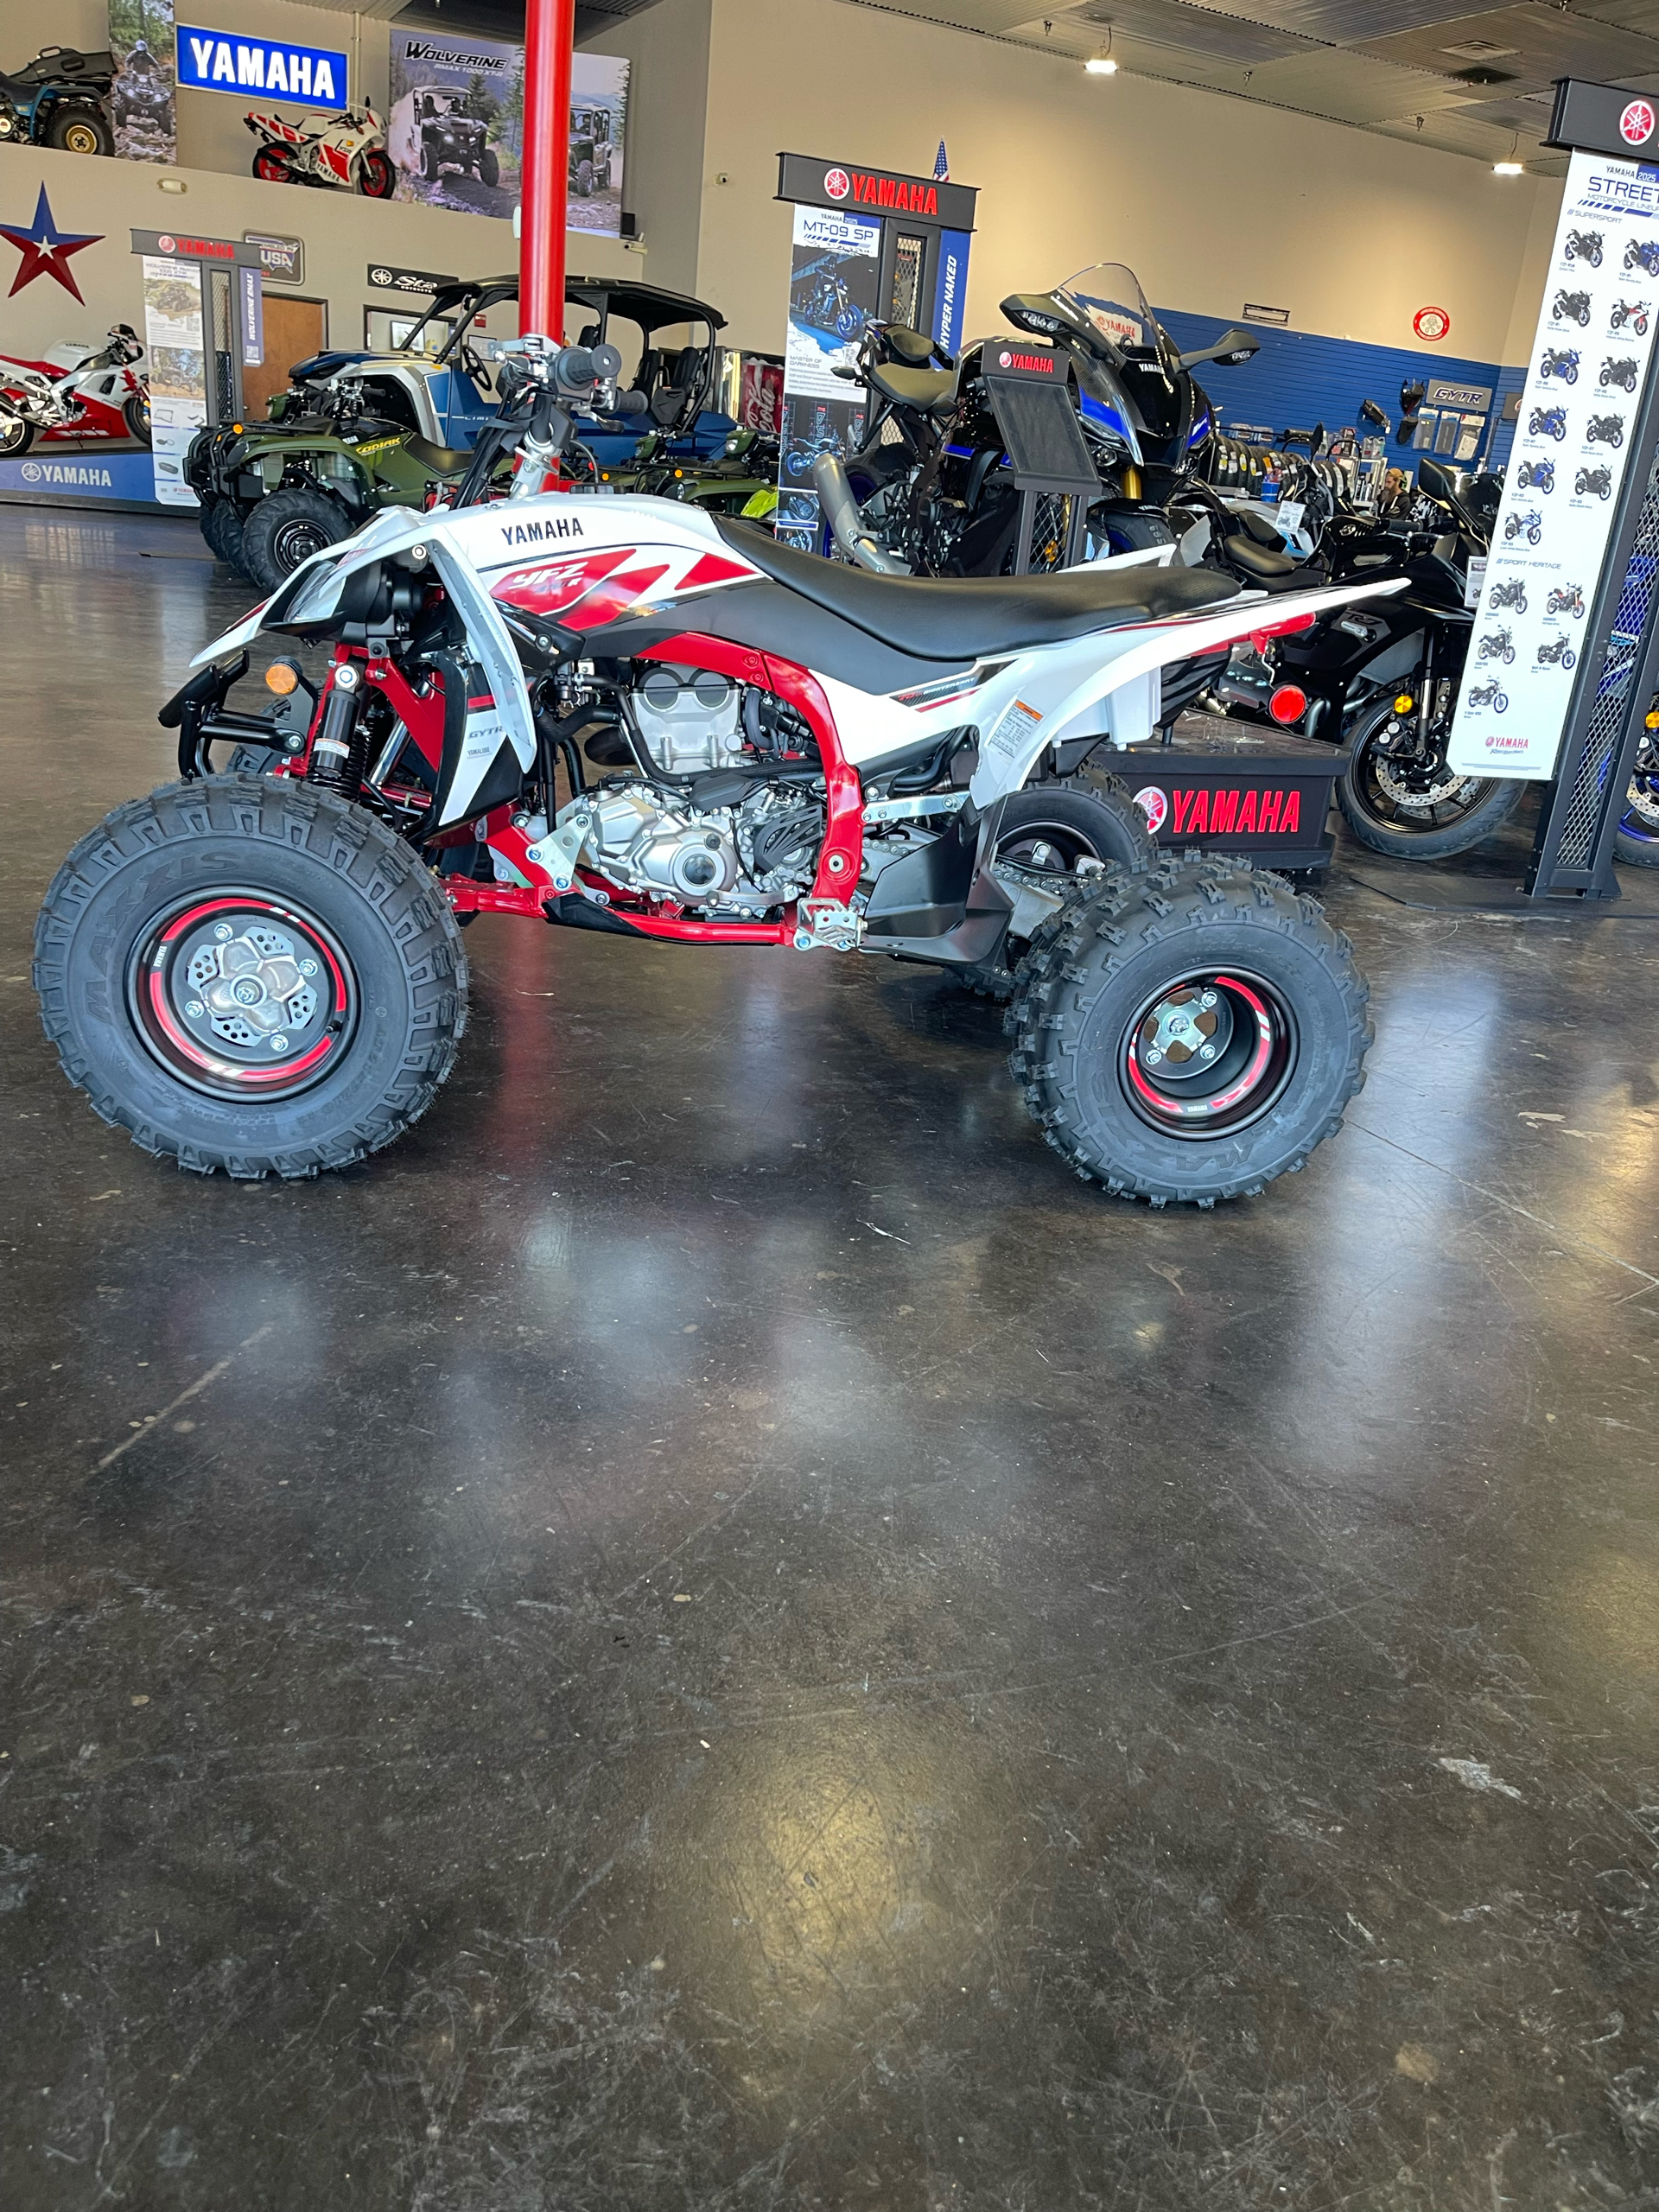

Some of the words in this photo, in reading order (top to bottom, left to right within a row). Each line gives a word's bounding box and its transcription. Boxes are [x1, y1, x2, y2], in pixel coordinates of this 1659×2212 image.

[404, 40, 510, 70] WOLVERINE
[190, 37, 335, 99] YAMAHA
[434, 63, 460, 72] RMAX
[462, 67, 483, 75] 1000
[317, 163, 340, 182] YAMAHA
[1606, 165, 1635, 178] YAMAHA
[1638, 171, 1656, 182] 2025
[851, 173, 938, 215] YAMAHA
[1587, 194, 1636, 207] MOTORCYCLE
[821, 213, 842, 222] YAMAHA
[1575, 210, 1623, 225] SUPERSPORT
[804, 219, 849, 238] MT-09
[854, 228, 874, 241] SP
[176, 238, 235, 259] YAMAHA
[260, 250, 294, 267] USA
[246, 272, 255, 296] RMAX
[944, 254, 957, 303] NAKED
[245, 297, 256, 341] WOLVERINE
[940, 302, 952, 349] HYPER
[1106, 317, 1135, 338] YAMAHA
[790, 360, 820, 369] DARKNESS
[1012, 353, 1053, 373] YAMAHA
[1433, 387, 1483, 404] GYTR
[355, 437, 400, 454] KODIAK
[42, 465, 111, 486] YAMAHA
[501, 518, 584, 545] YAMAHA
[507, 562, 588, 589] YFZ
[1529, 561, 1561, 569] HERITAGE
[924, 677, 975, 695] ANNIVERSARY
[467, 726, 503, 739] GYTR
[1496, 737, 1529, 748] YAMAHA
[1173, 790, 1300, 833] YAMAHA
[86, 852, 241, 1025] MAXXIS
[152, 945, 168, 968] YAMAHA
